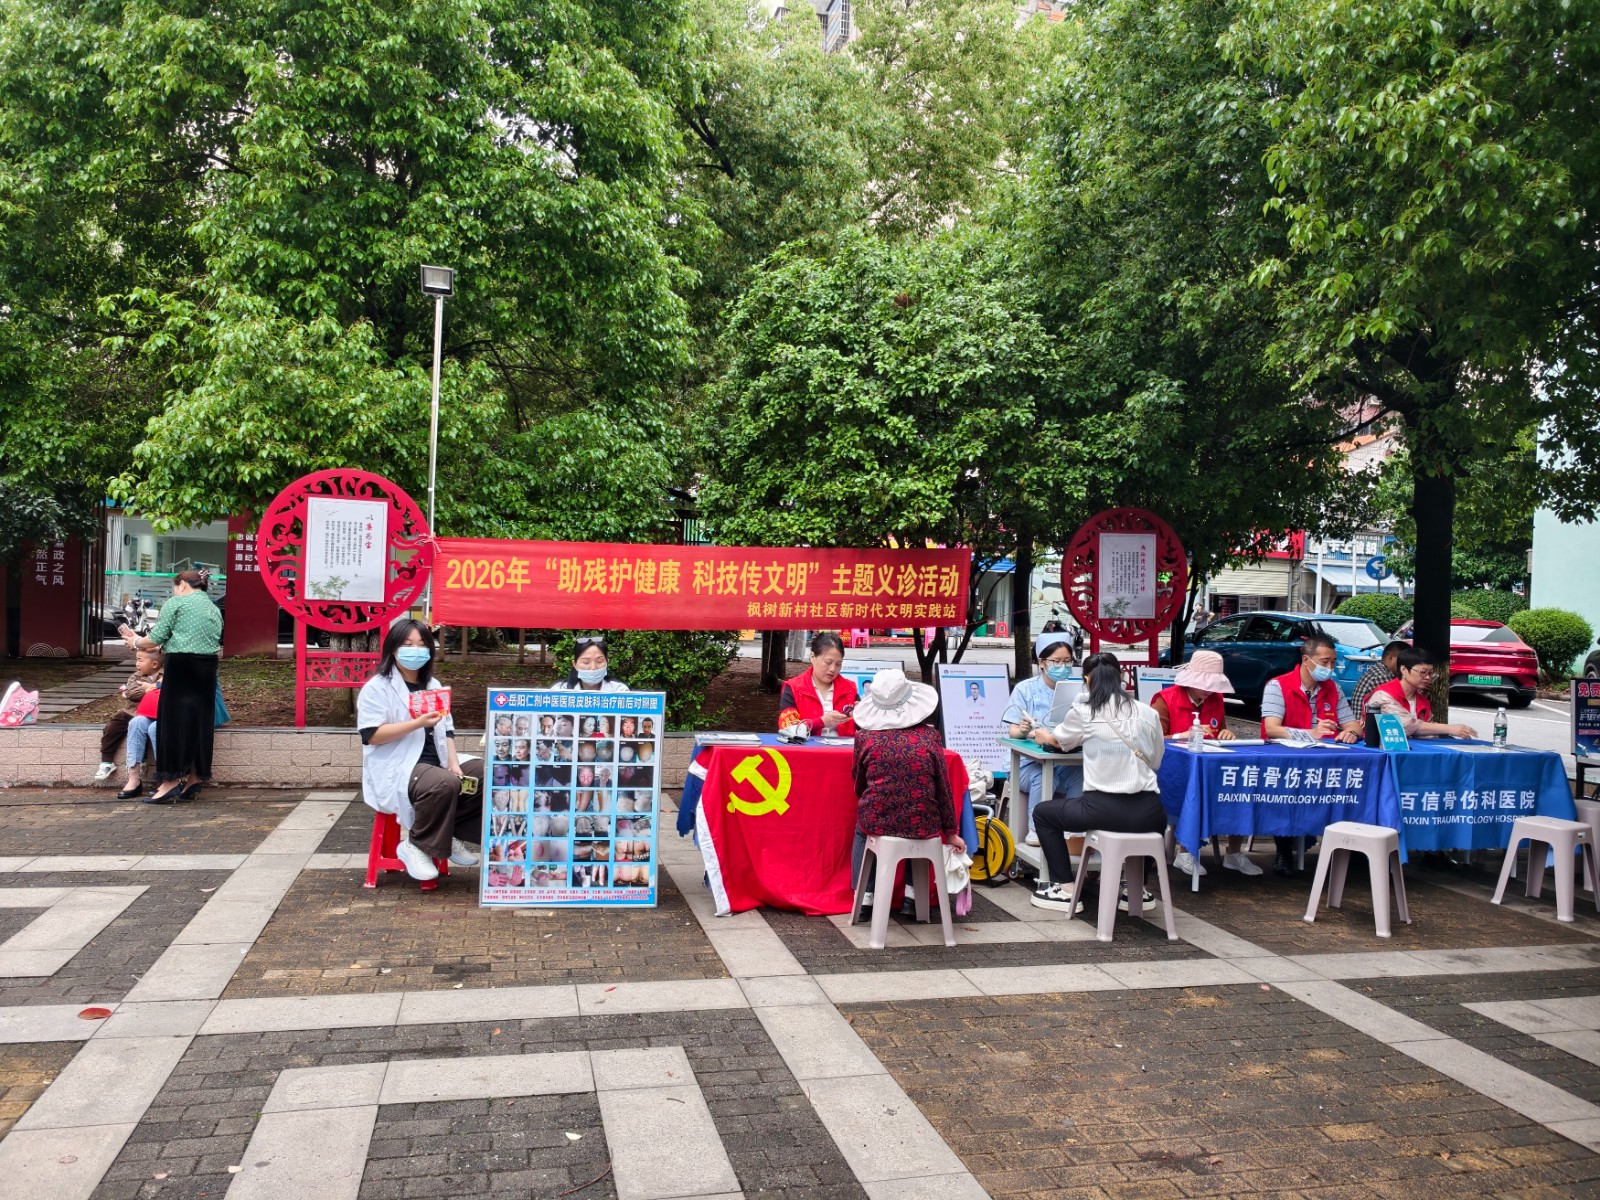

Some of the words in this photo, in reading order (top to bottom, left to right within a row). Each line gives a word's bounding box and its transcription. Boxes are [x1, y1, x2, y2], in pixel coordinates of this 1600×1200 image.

[235, 543, 258, 551] 担当
[235, 553, 258, 561] 遵纪
[446, 556, 531, 593] 2026年
[545, 557, 681, 595] “助残护健康
[692, 560, 819, 596] 科技传文明”
[830, 563, 960, 598] 主题义诊活动
[747, 601, 956, 619] 枫树新村社区新时代文明实践站
[1220, 765, 1364, 789] 百信骨伤科医院
[1218, 793, 1250, 803] BAIXIN
[1252, 793, 1318, 804] TRAUMTOLOGY
[1319, 794, 1360, 804] HOSPITAL
[1400, 790, 1536, 811] 百信骨伤科医院
[1402, 816, 1429, 825] AIXIN
